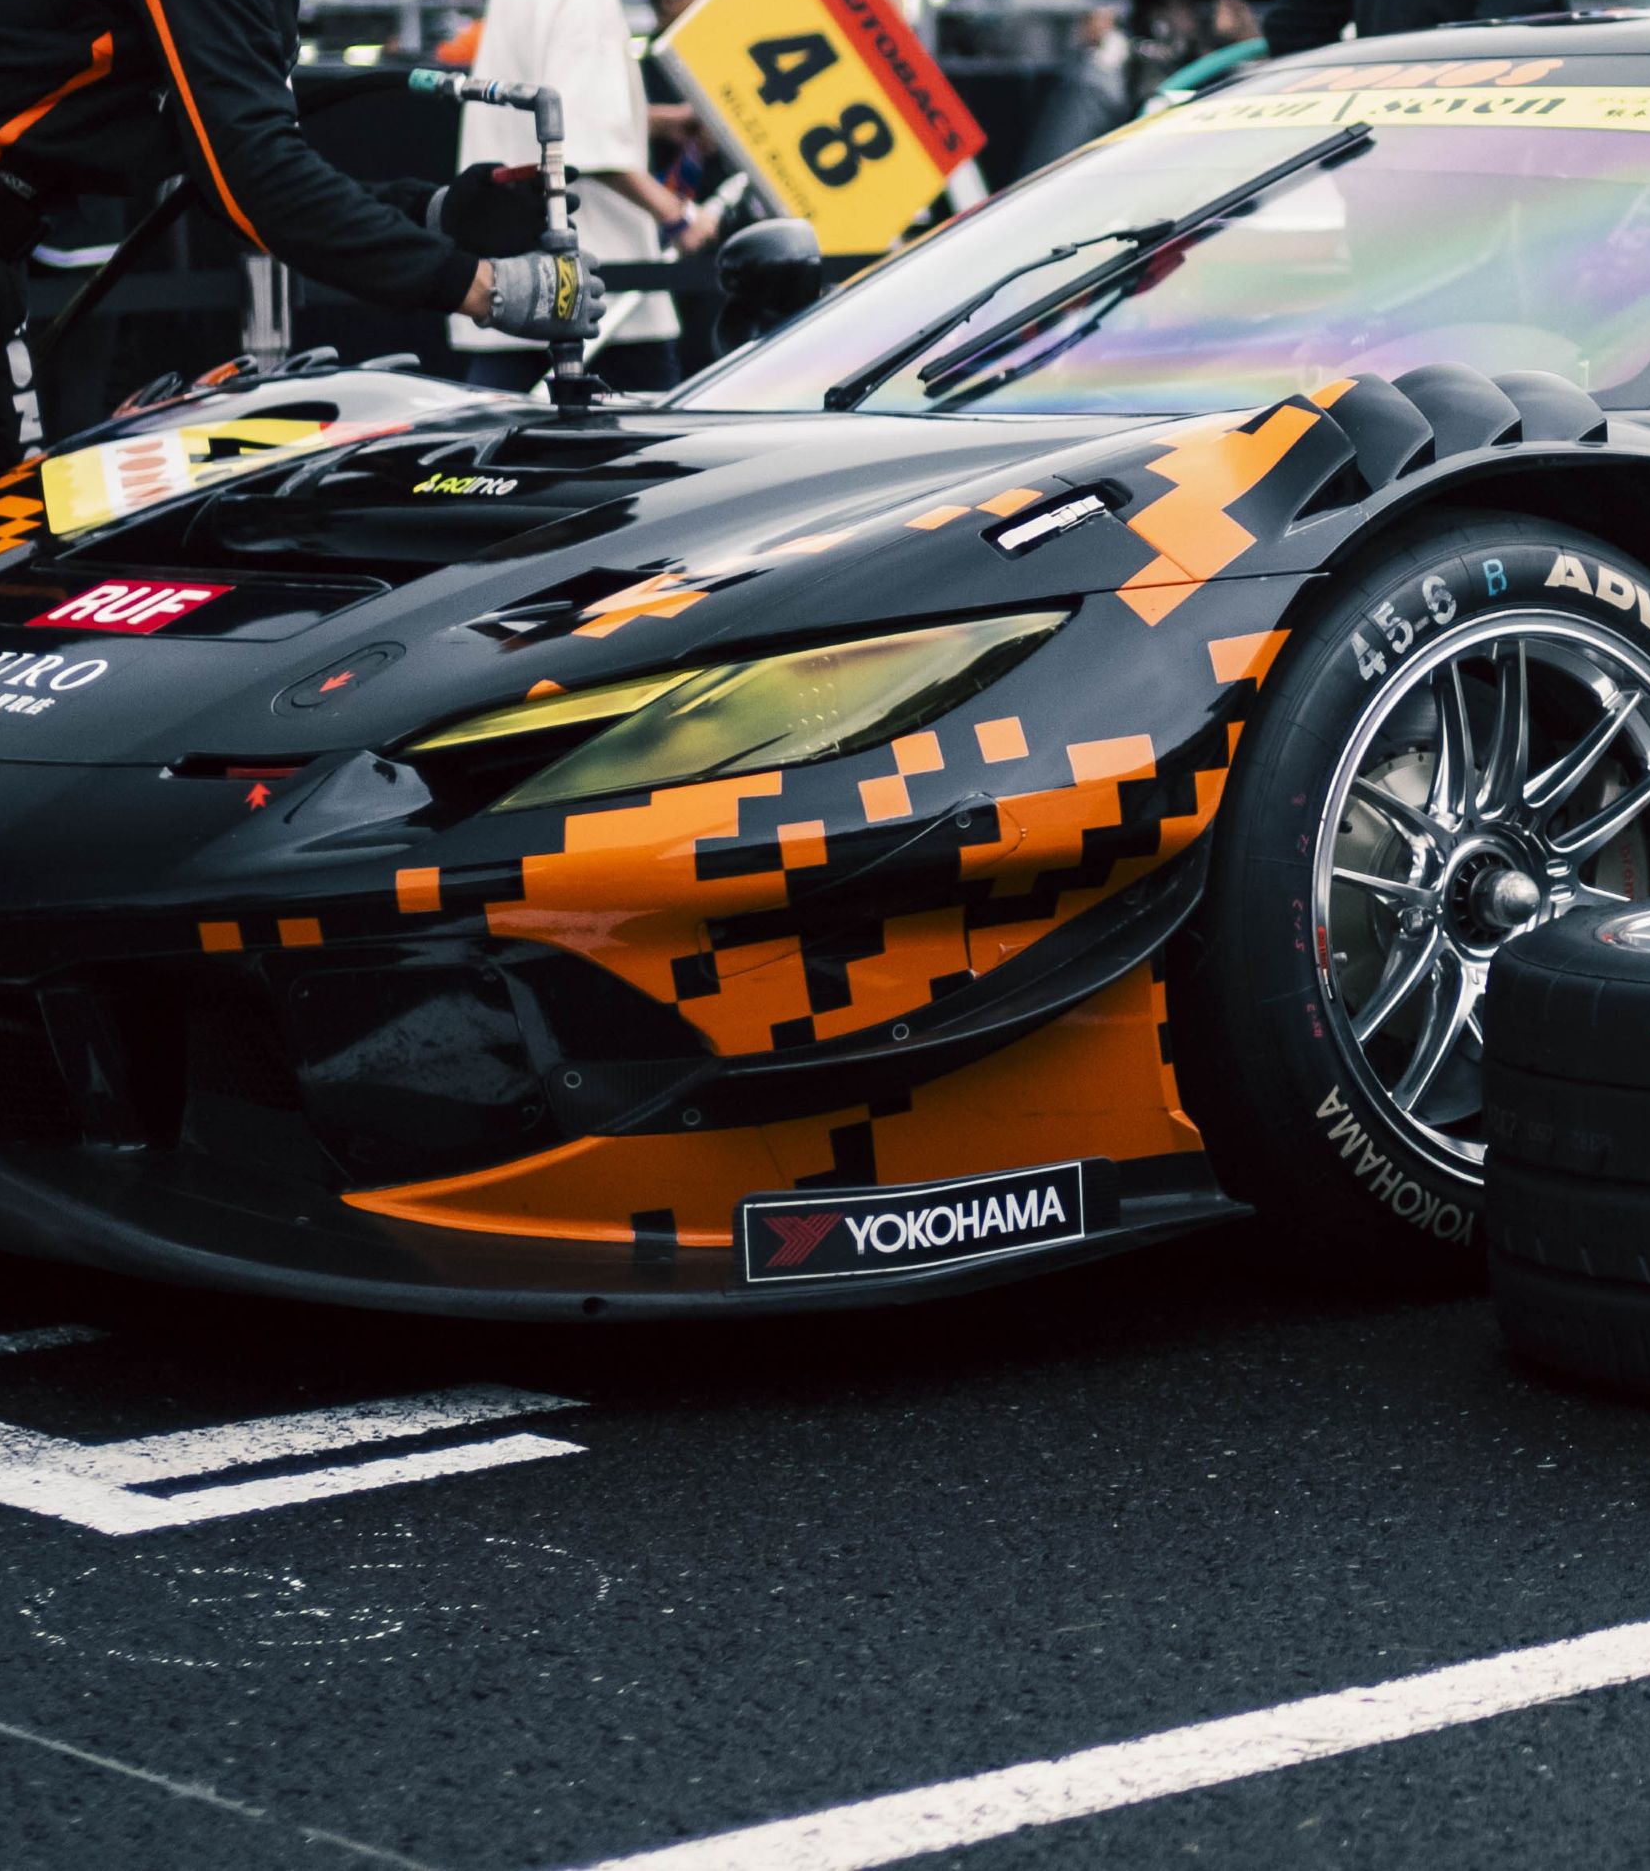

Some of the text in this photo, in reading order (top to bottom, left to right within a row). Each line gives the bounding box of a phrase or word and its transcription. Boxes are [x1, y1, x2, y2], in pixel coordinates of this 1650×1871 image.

[747, 33, 896, 189] 48
[47, 585, 212, 625] RUF
[845, 1186, 1066, 1255] YOKOHAMA
[1315, 1084, 1475, 1247] YOKOHAMA
